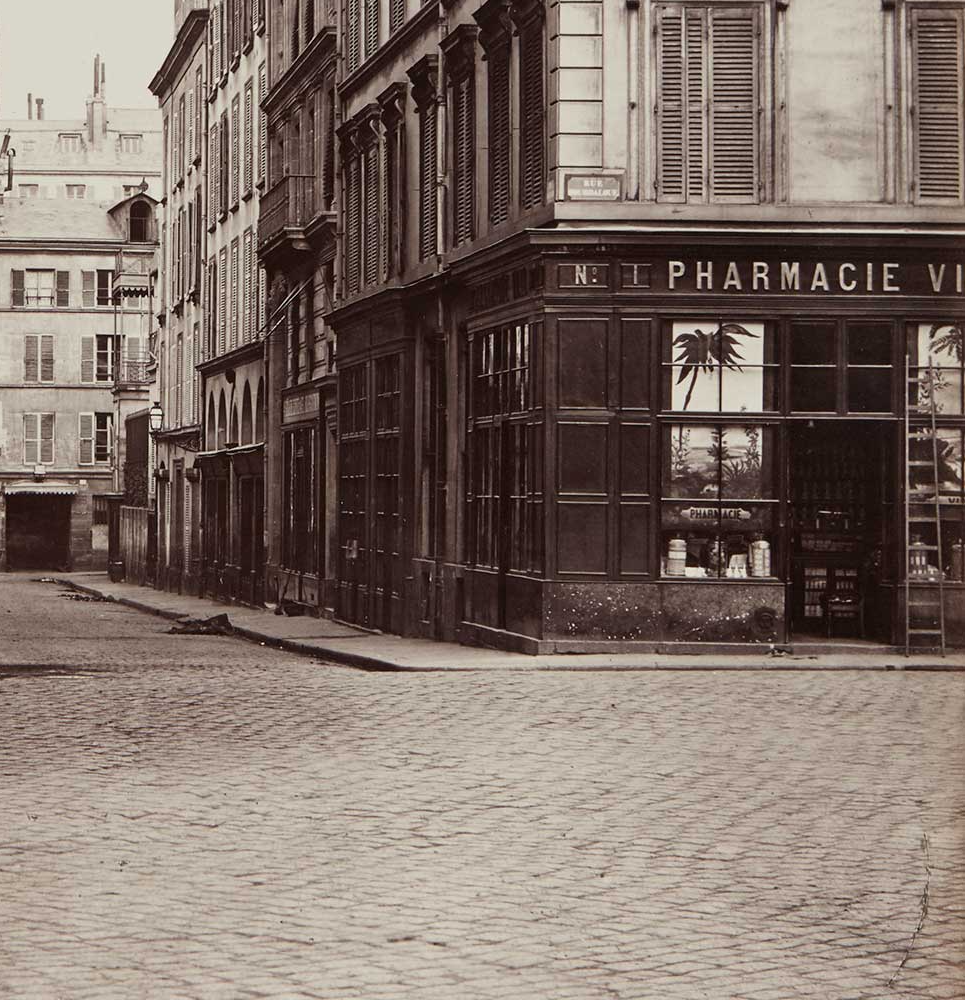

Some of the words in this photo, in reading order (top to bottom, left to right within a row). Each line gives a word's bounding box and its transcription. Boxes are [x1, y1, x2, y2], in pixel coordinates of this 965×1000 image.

[583, 180, 604, 188] RUE
[668, 261, 901, 292] PHARMACIE
[928, 263, 963, 293] VI
